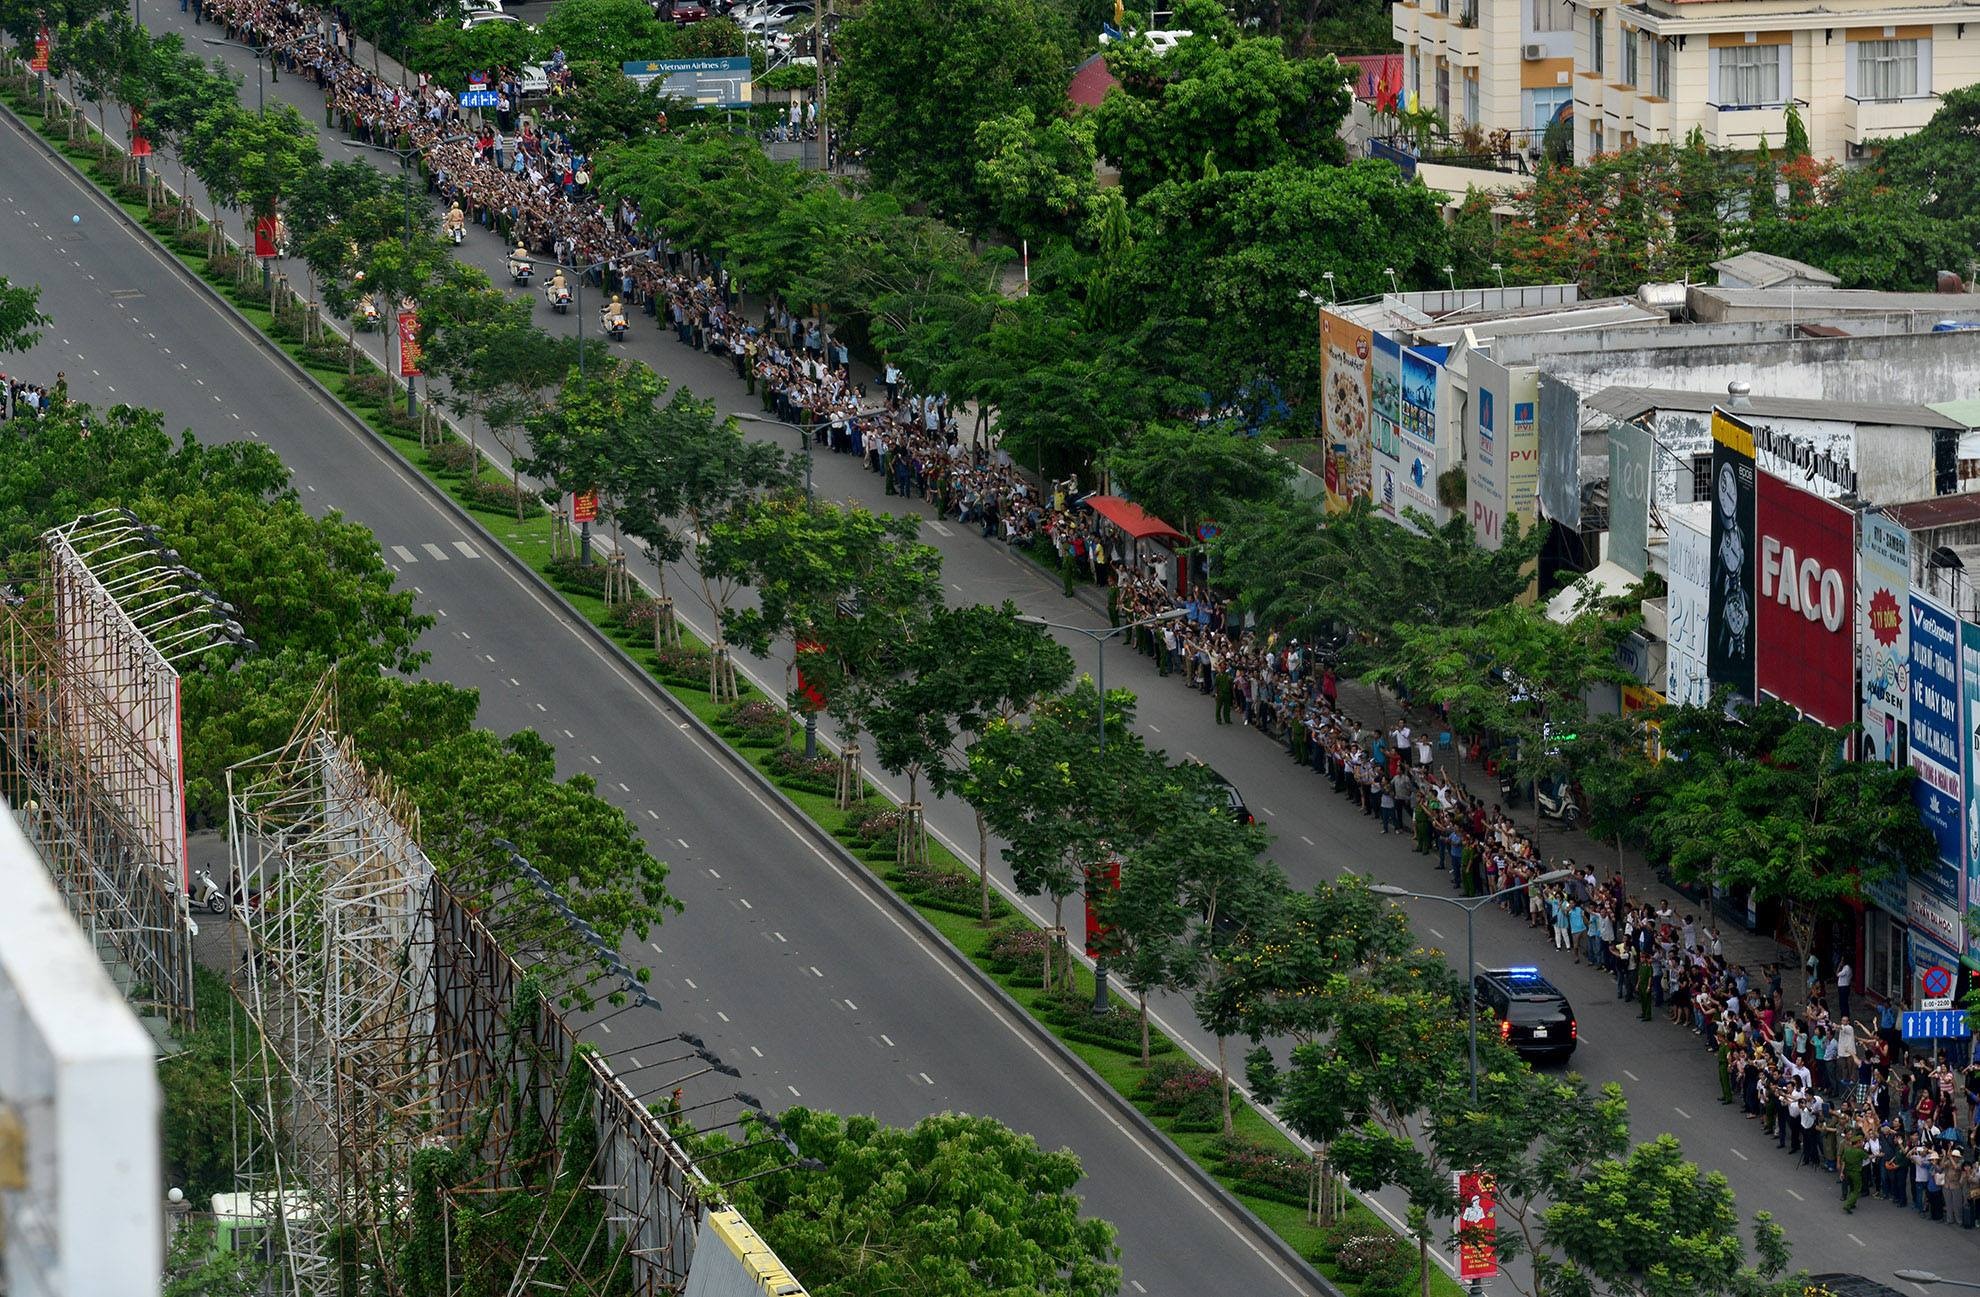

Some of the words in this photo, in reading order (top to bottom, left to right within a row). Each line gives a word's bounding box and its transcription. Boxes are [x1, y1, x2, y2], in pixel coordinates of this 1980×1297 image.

[660, 62, 691, 71] Vietnam
[691, 61, 719, 70] Airlines
[1510, 450, 1537, 462] PVI
[1608, 437, 1647, 503] Tea
[1474, 500, 1498, 540] PVI
[1762, 535, 1845, 632] FACO
[1914, 677, 1923, 704] VÉ
[1925, 685, 1940, 713] MÁY
[1941, 696, 1955, 722] BAY
